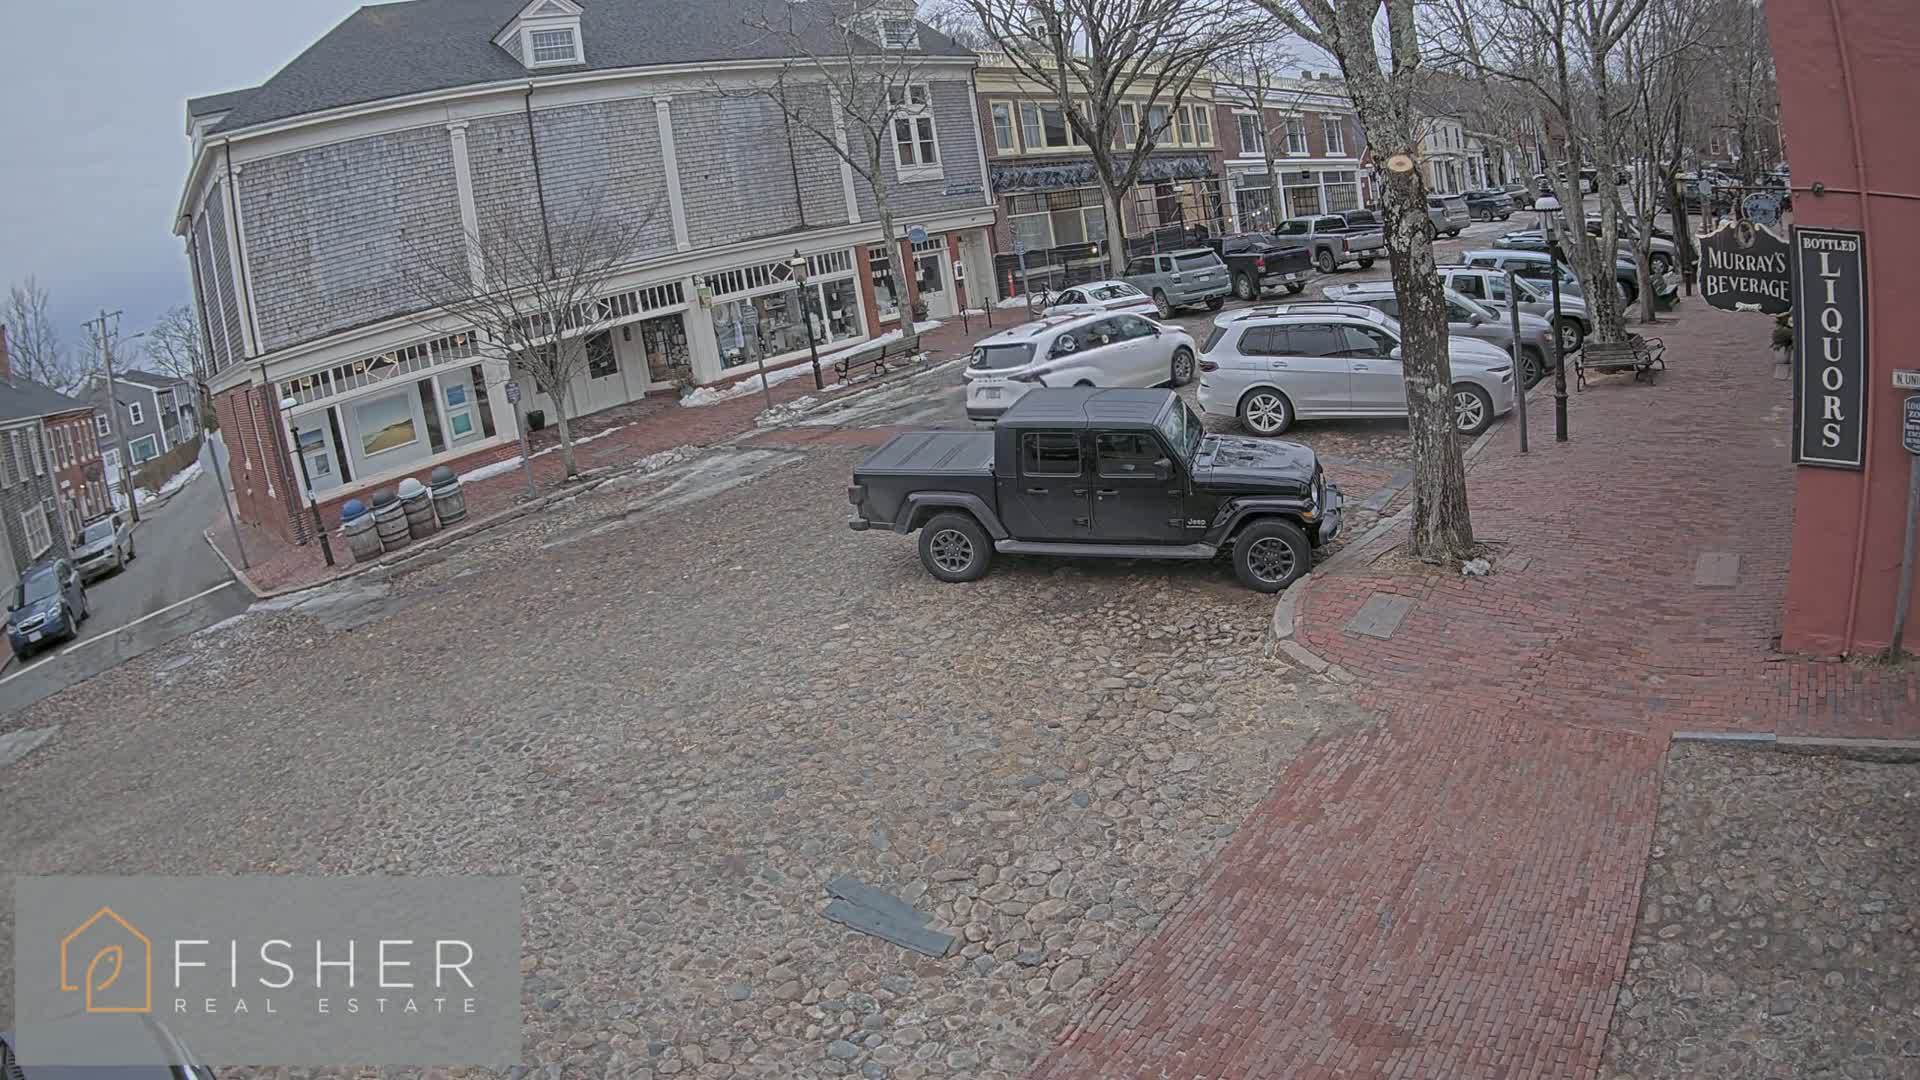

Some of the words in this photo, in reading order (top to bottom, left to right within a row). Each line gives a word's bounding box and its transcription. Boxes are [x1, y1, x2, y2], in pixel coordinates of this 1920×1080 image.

[1803, 238, 1857, 251] BOTTLED
[1708, 247, 1786, 273] MURRAY'S
[1706, 275, 1790, 302] BEVERAGE
[1819, 252, 1844, 448] LIQUORS
